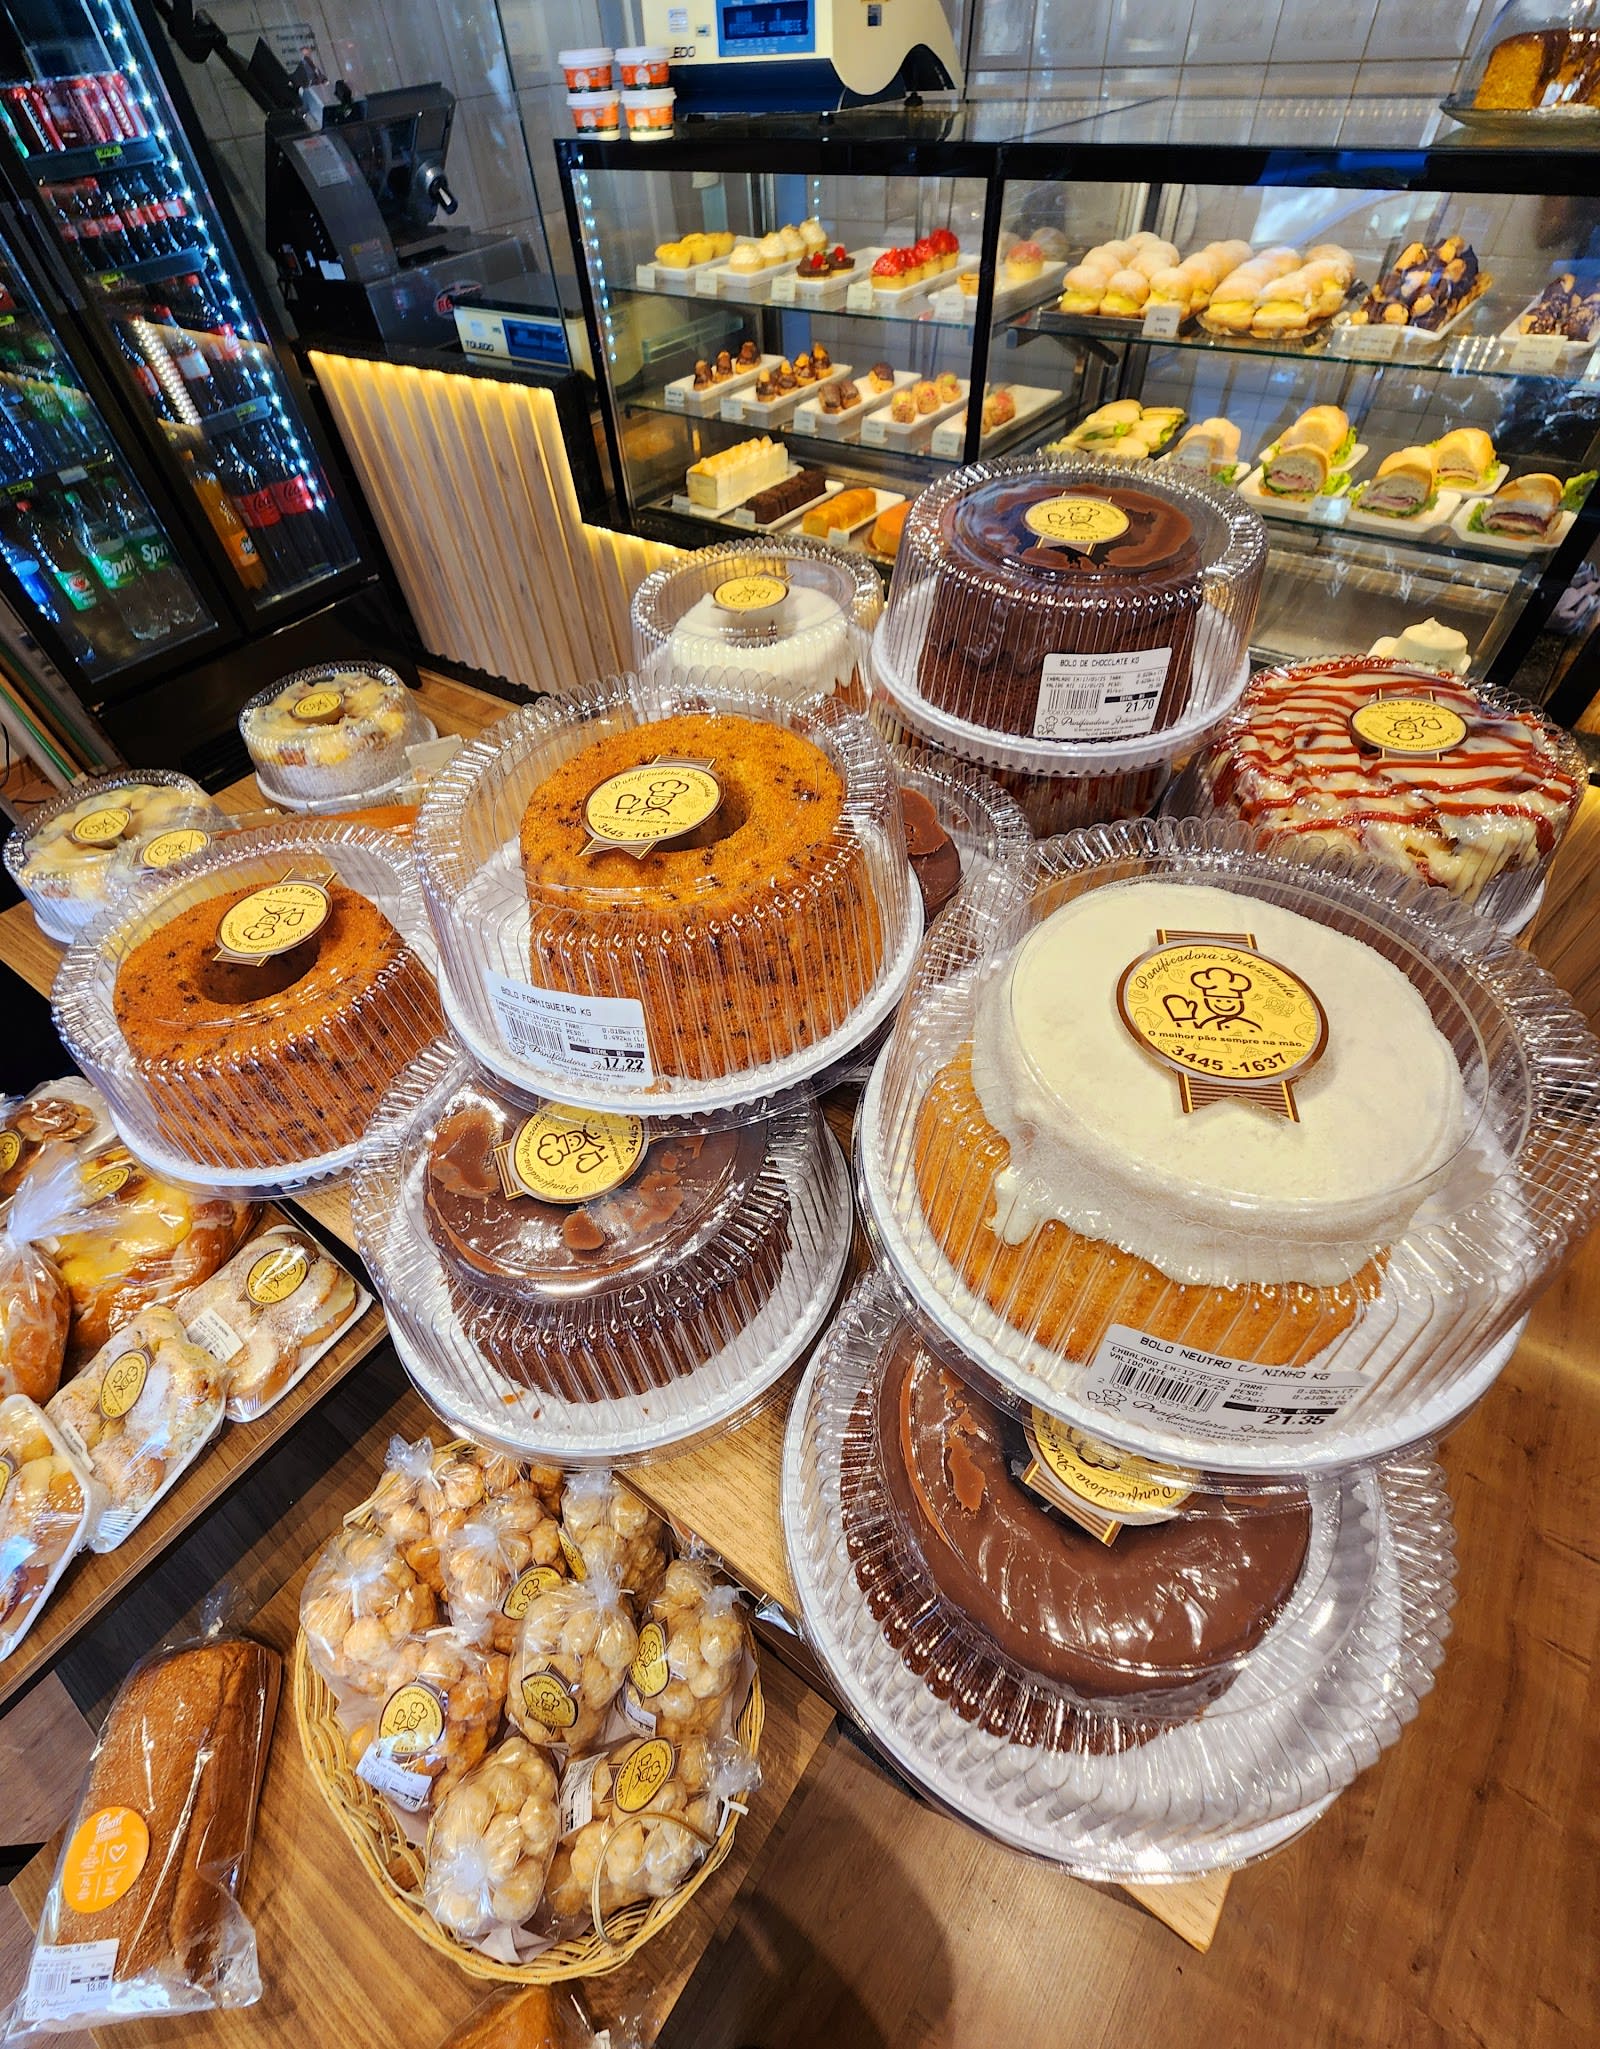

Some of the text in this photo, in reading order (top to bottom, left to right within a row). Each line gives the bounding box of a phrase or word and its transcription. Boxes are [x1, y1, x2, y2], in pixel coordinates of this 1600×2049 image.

[464, 339, 495, 352] TOLEDO
[1059, 659, 1077, 667] BOLO
[1080, 659, 1089, 667] DE
[1091, 657, 1128, 667] CHOCOLATE
[1125, 699, 1155, 713] 21.70
[598, 822, 626, 838] 3445
[1135, 950, 1219, 990] Panificadora
[500, 985, 592, 1017] BOLO FORMIGUEIRO KG
[1159, 1031, 1195, 1041] melhor
[1198, 1033, 1218, 1043] pão
[1220, 1037, 1260, 1046] sempre
[1279, 1039, 1306, 1048] mão.
[1171, 1045, 1287, 1073] 3445 -1637
[625, 1124, 639, 1154] 3445
[523, 1159, 579, 1194] Panificadora
[1111, 1346, 1159, 1367] EMBALADO
[1238, 1382, 1268, 1390] TARA:
[1140, 1336, 1331, 1381] BOLO NEUTRO C/ NINHO KG
[1109, 1351, 1144, 1369] VALIDO
[1233, 1388, 1264, 1397] PESO:
[1132, 1400, 1228, 1430] Panificadora
[1263, 1415, 1329, 1425] 21.35
[1075, 1471, 1177, 1501] Panificadora
